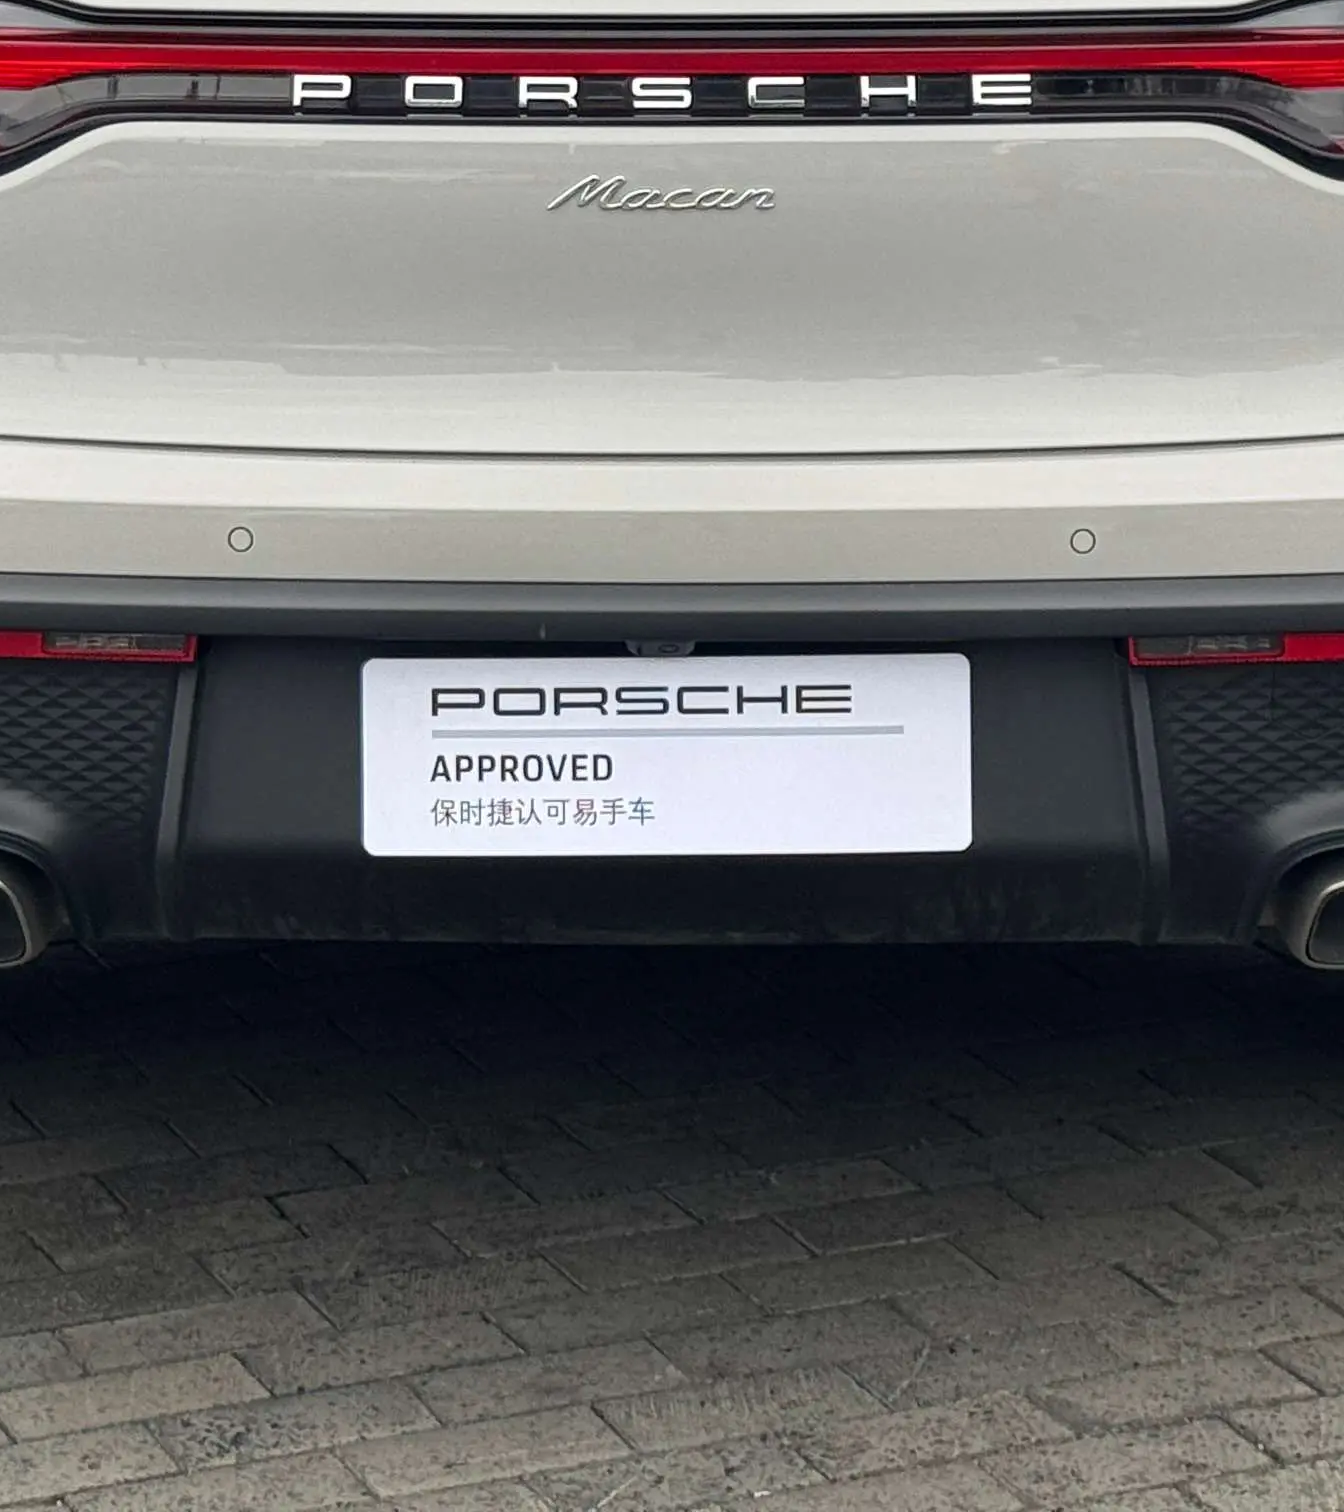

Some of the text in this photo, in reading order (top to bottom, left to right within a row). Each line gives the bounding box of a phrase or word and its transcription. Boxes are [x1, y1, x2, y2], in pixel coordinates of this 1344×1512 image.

[291, 72, 1033, 110] PORSCHE
[546, 174, 775, 211] Macan
[431, 684, 852, 717] PORSCHE
[430, 754, 614, 783] APPROVED
[431, 797, 656, 827] 保时捷认可易手车
